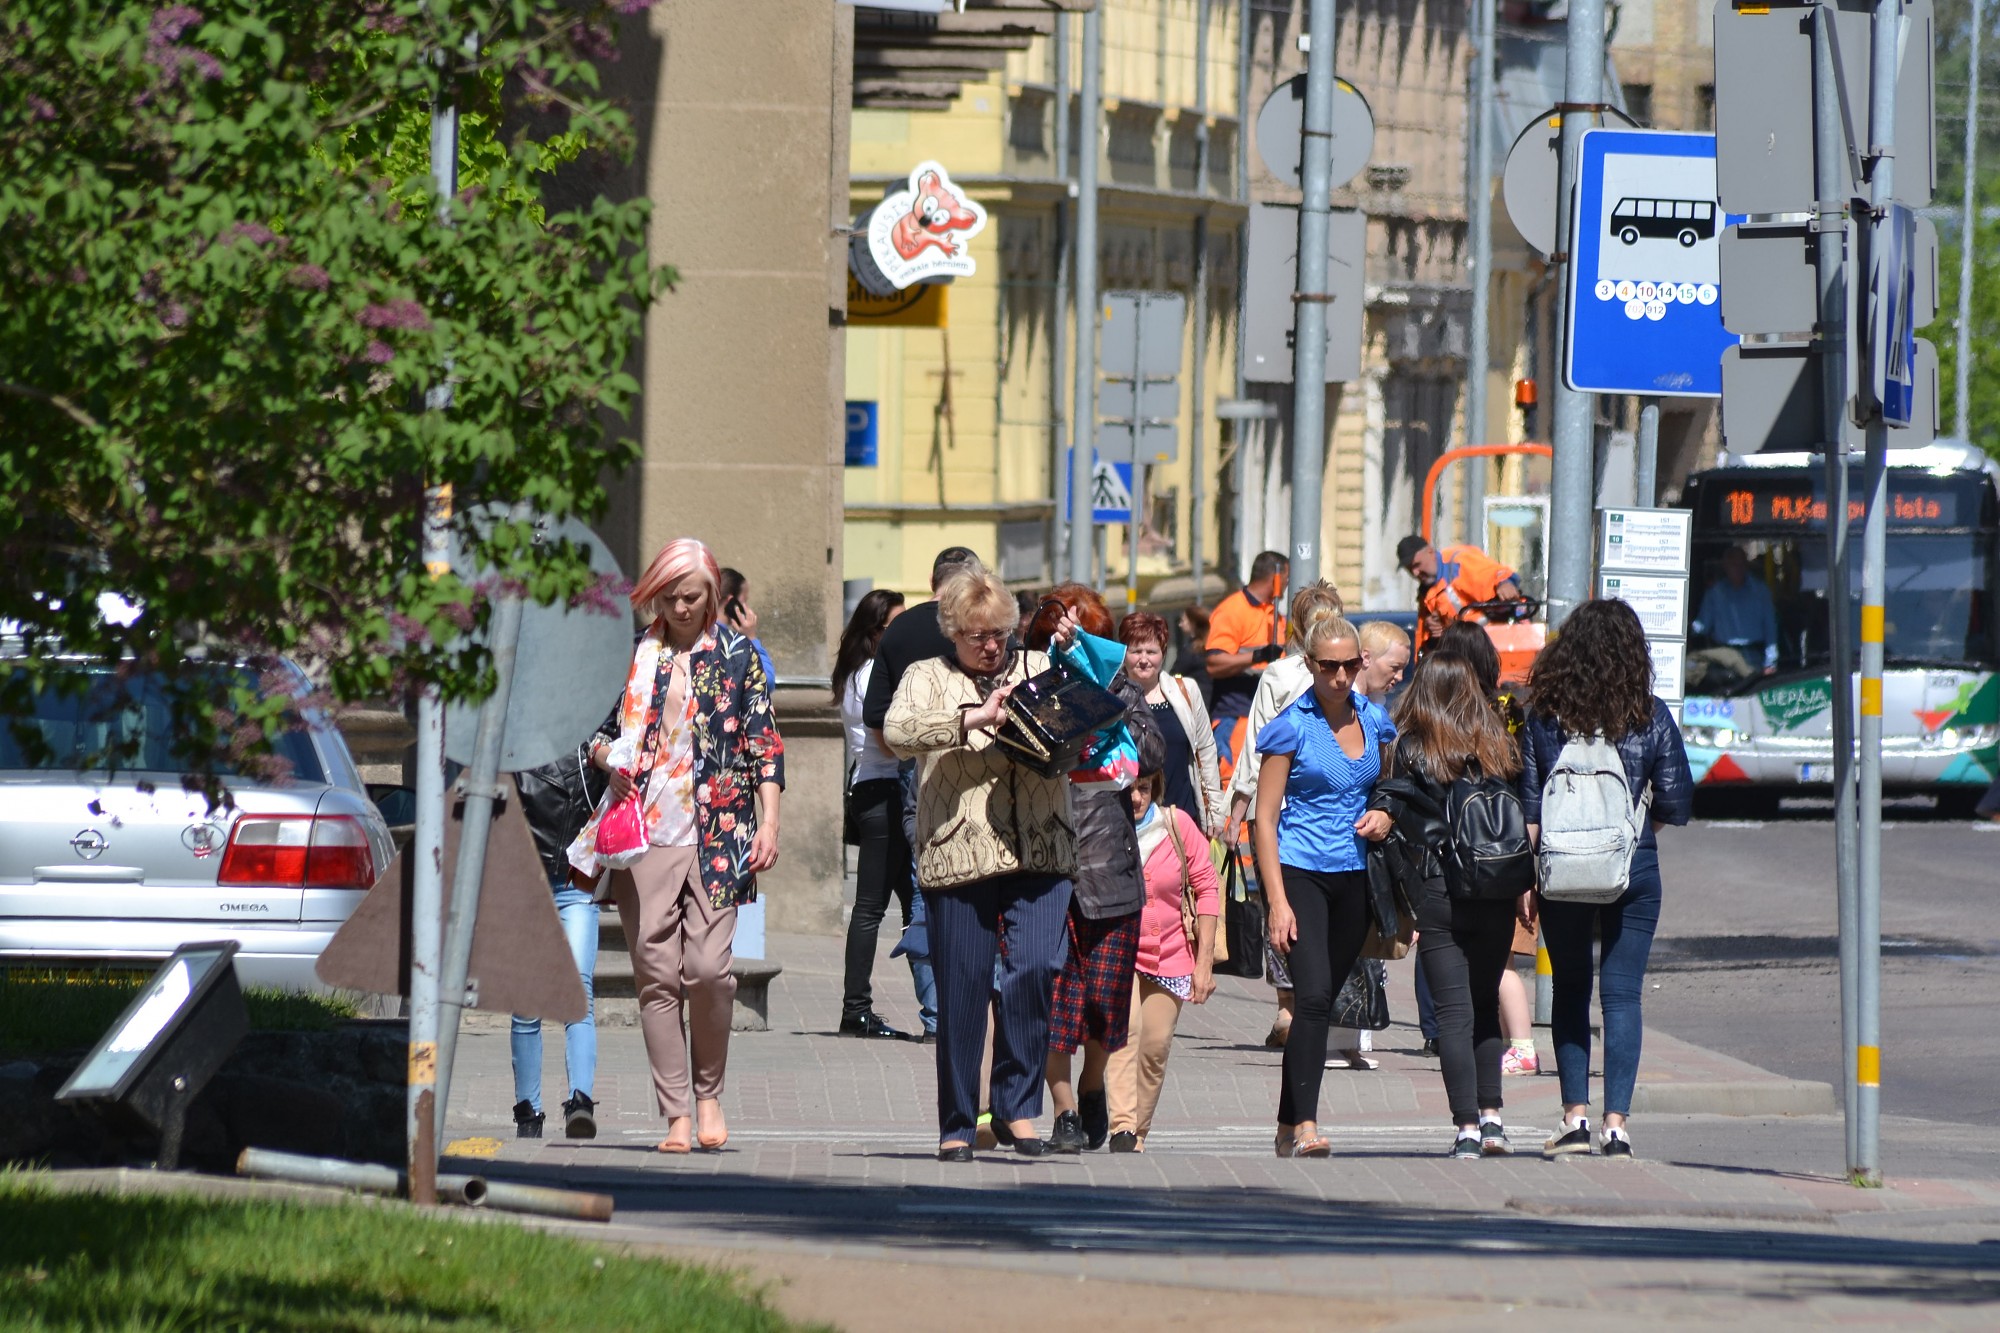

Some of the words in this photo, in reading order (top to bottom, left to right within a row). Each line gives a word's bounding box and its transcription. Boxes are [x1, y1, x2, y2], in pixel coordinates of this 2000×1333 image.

[1601, 285, 1609, 296] 3
[1621, 286, 1629, 297] 4
[1639, 287, 1654, 298] 10
[1658, 287, 1673, 298] 14
[1679, 288, 1694, 299] 15
[1703, 289, 1711, 299] 6
[1626, 304, 1644, 314] 702
[1646, 305, 1664, 315] 912
[1726, 490, 1755, 525] 10
[1761, 687, 1828, 706] LIEPĀJA
[219, 903, 270, 912] OMEGA
